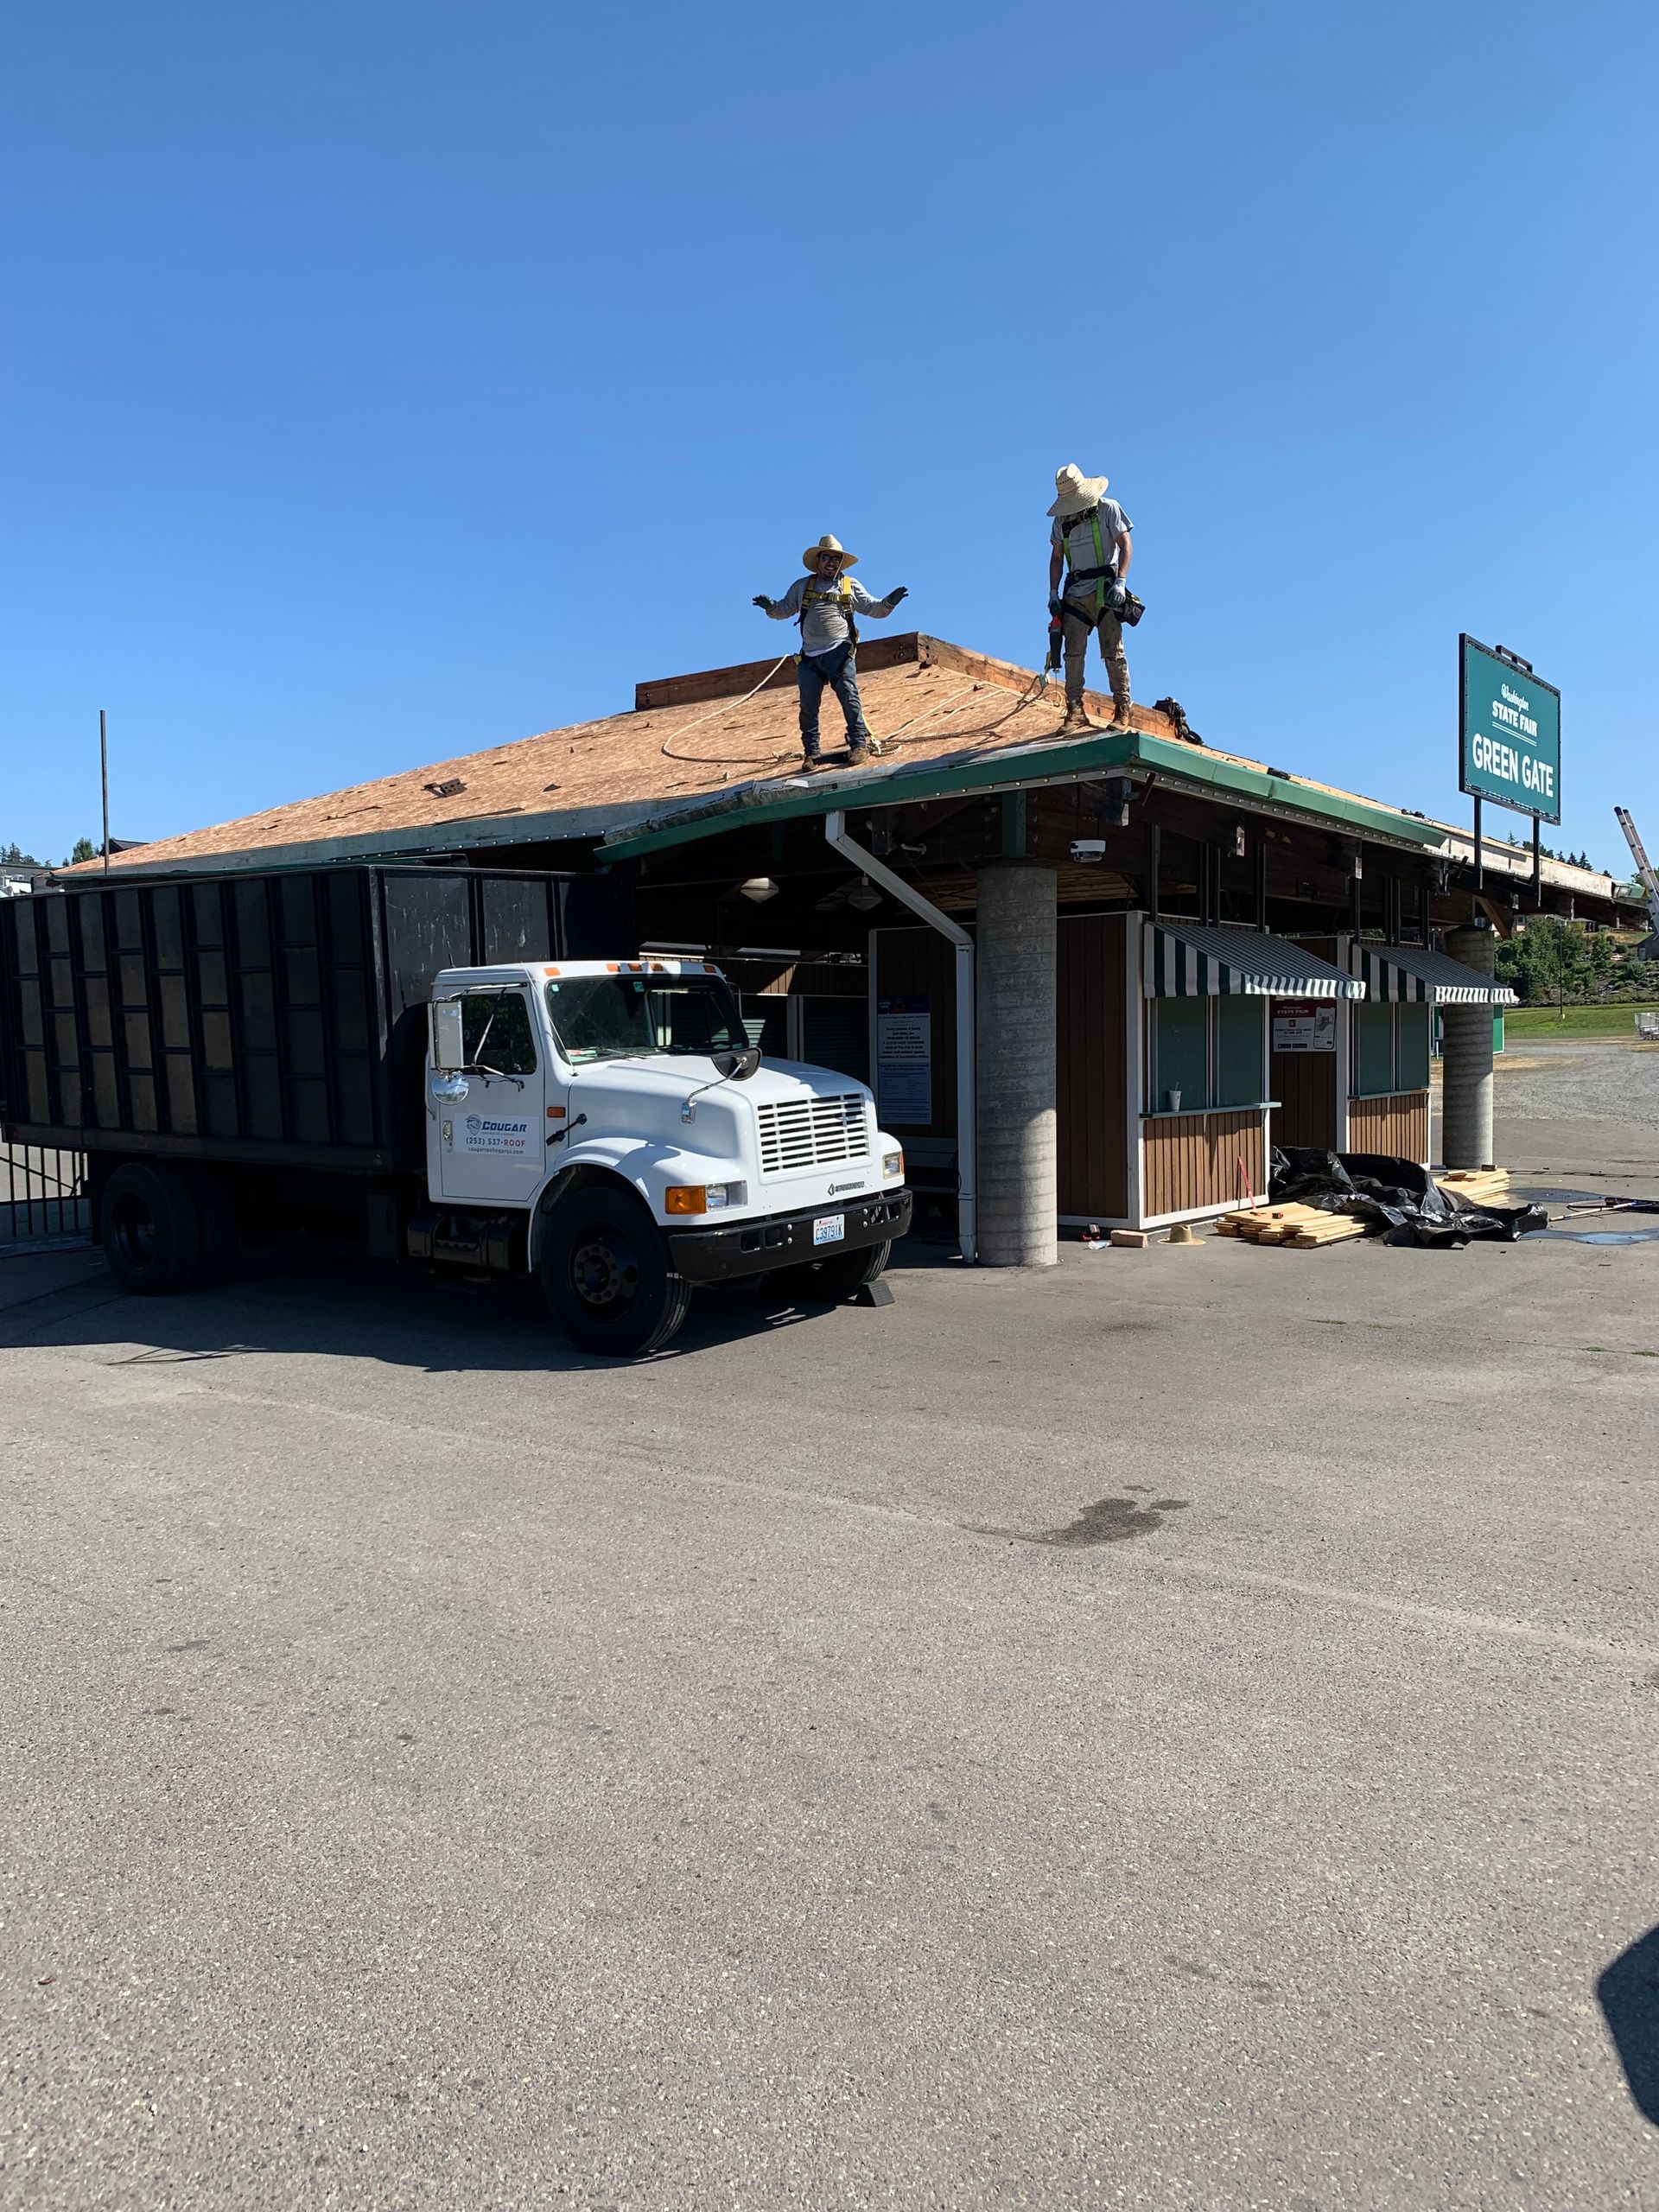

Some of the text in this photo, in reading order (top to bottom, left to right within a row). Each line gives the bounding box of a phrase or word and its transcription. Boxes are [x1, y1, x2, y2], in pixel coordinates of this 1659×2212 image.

[1501, 683, 1529, 712] Washington
[1492, 700, 1537, 737] STATE FAIR
[1472, 733, 1554, 798] GREEN GATE
[482, 1121, 527, 1132] COUGAR
[466, 1136, 526, 1147] (253) 537-ROOF
